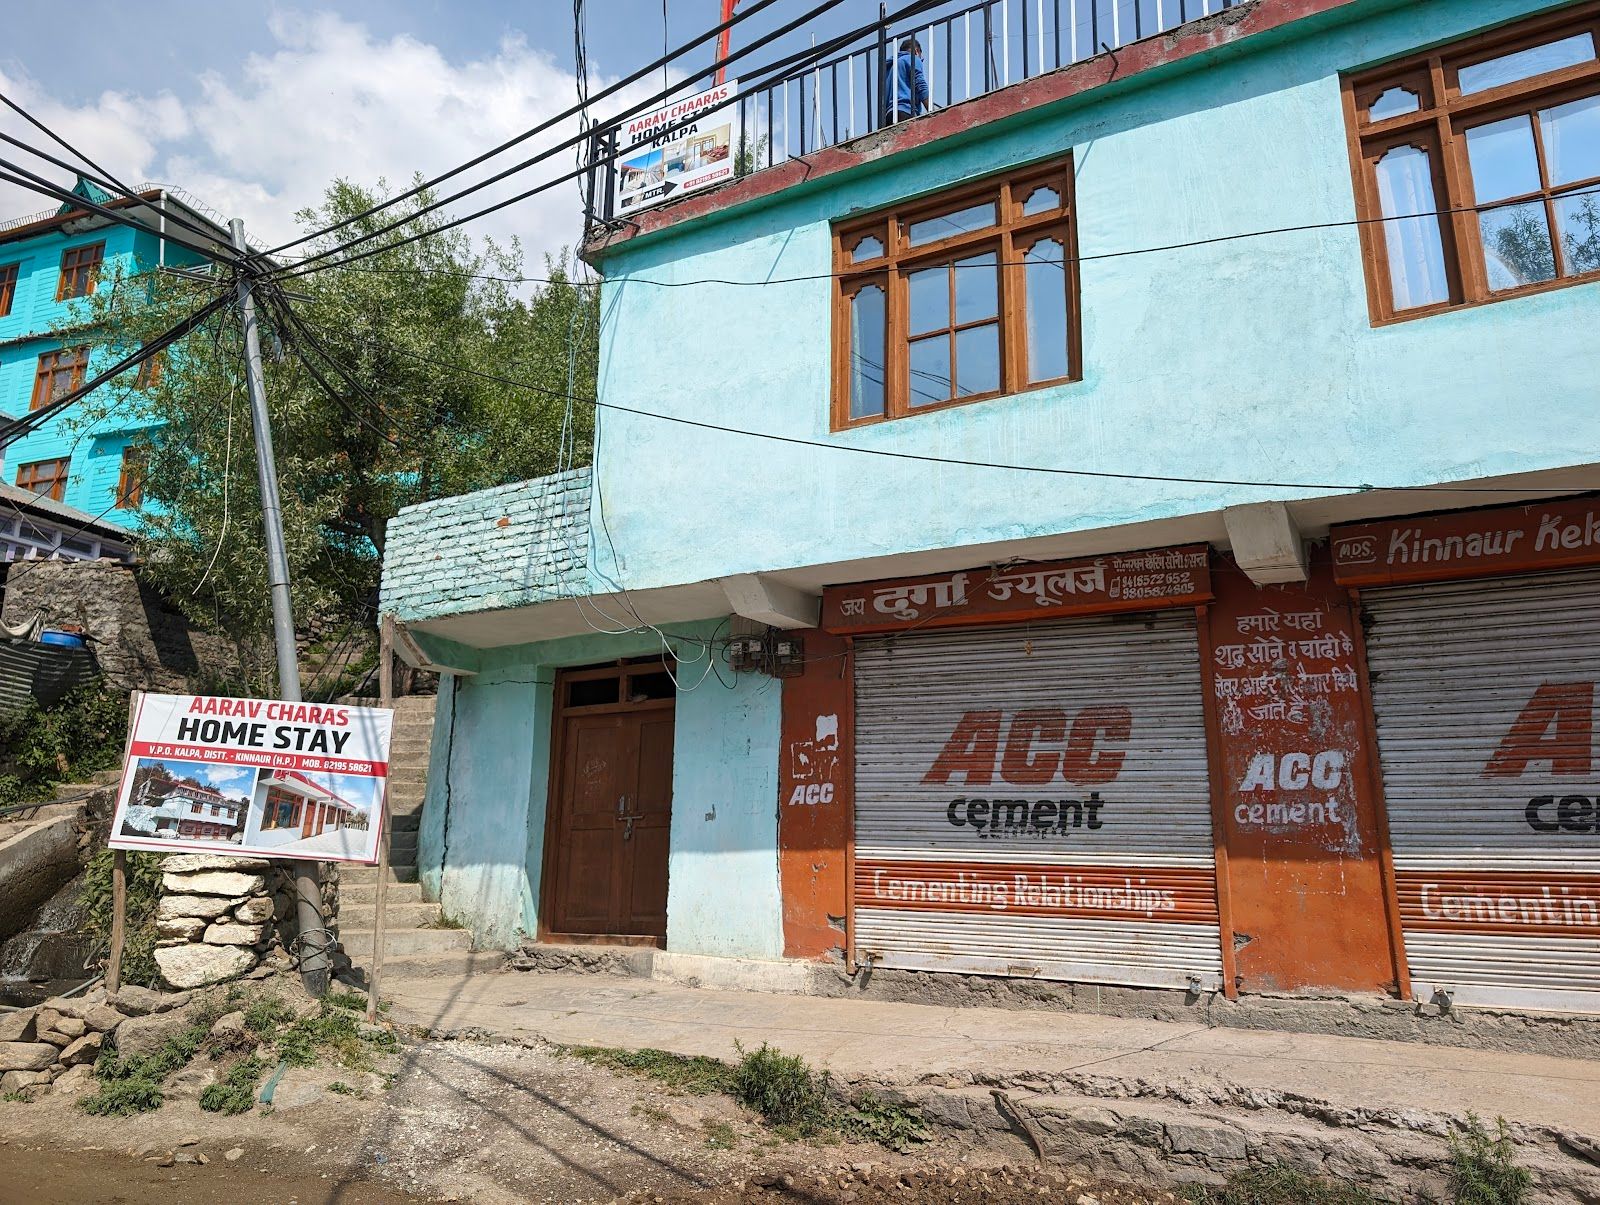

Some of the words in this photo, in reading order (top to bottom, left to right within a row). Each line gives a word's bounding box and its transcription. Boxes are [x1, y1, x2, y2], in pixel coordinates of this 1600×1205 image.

[628, 110, 668, 135] AARAV
[671, 87, 728, 117] CHAARAS
[652, 124, 698, 149] KALPA
[1387, 528, 1524, 564] Kinnaur
[840, 598, 866, 616] जय
[1236, 607, 1280, 634] हमारे
[1283, 608, 1323, 632] यहां
[1247, 636, 1285, 663] सोने
[1339, 630, 1354, 656] के
[189, 696, 262, 718] AARAV
[266, 703, 349, 727] CHARAS
[177, 717, 267, 747] HOME
[273, 726, 352, 754] STAY
[919, 705, 1132, 786] ACC
[149, 745, 172, 756] V.P.O.
[174, 748, 202, 759] KALPA,
[204, 750, 228, 761] DISTT.
[235, 753, 271, 764] KINNAUR
[273, 755, 297, 767] (H.P.)
[302, 759, 322, 769] MOB.
[324, 760, 347, 771] 82195
[349, 762, 373, 773] 58621
[1238, 750, 1345, 791] ACC
[789, 782, 834, 806] ACC
[947, 791, 1105, 830] cement
[1234, 797, 1341, 824] cement
[1525, 794, 1600, 831] ce
[873, 869, 1008, 910] Cementing
[1014, 874, 1176, 918] Relationships
